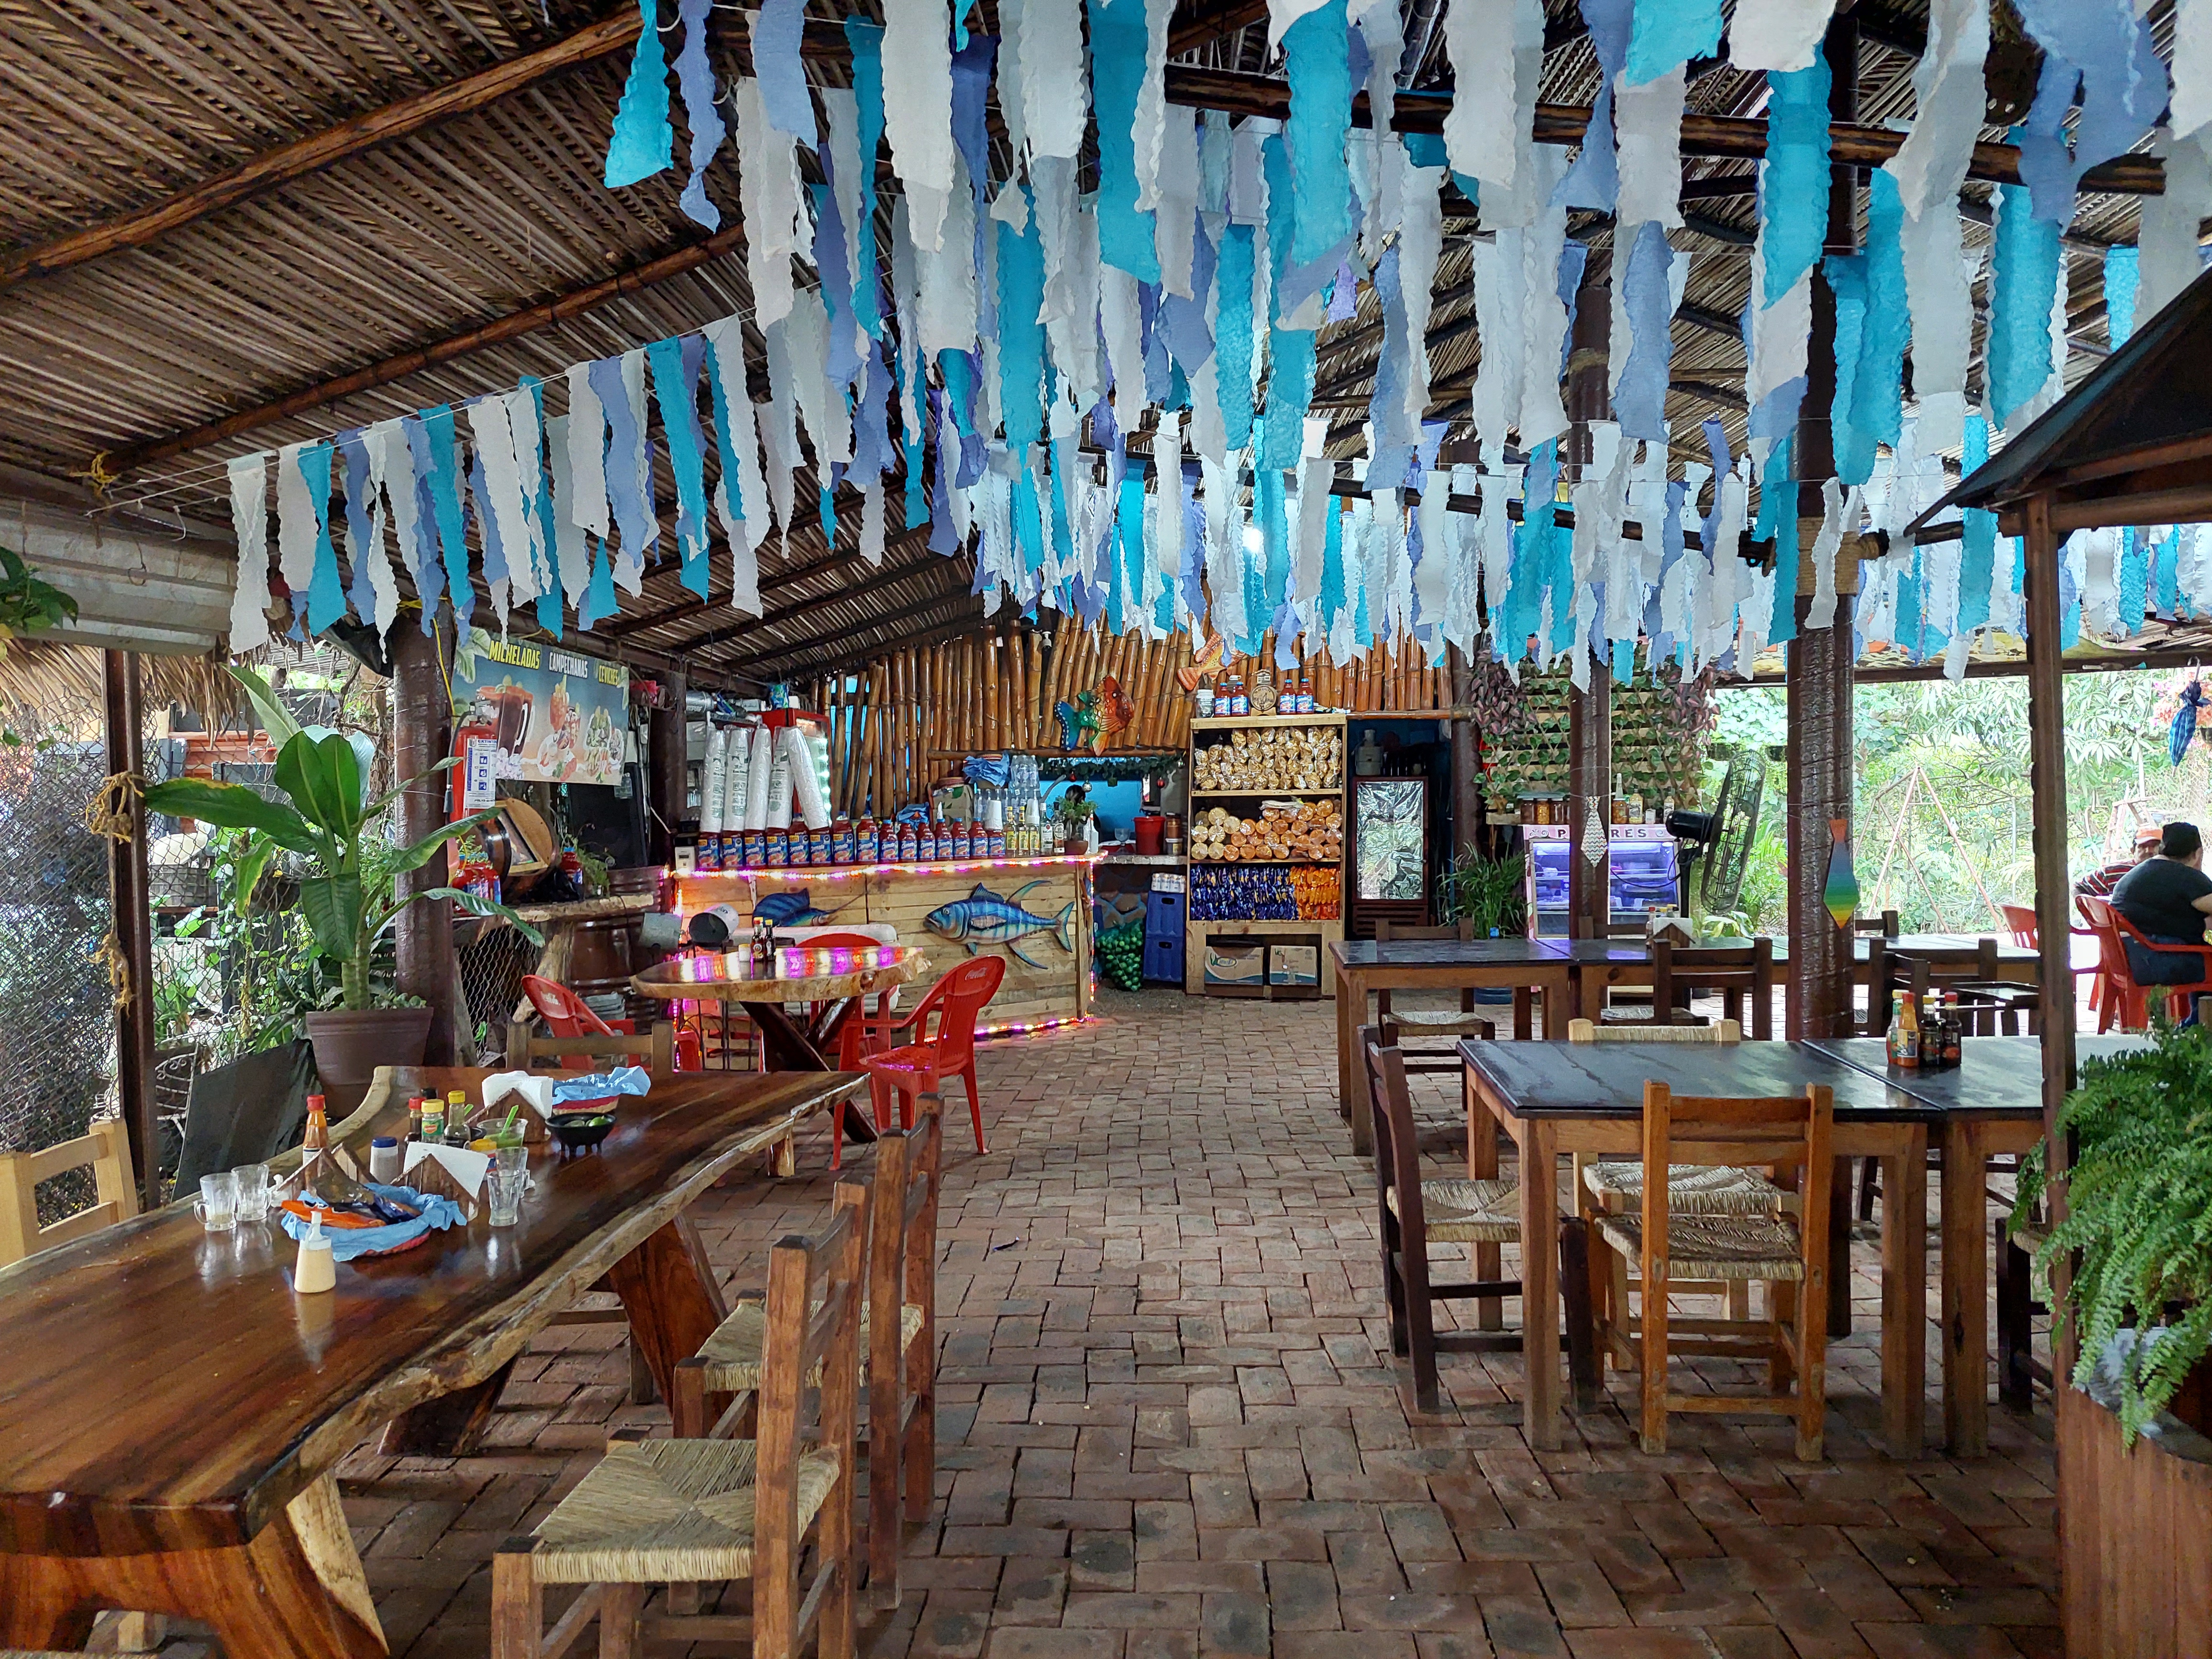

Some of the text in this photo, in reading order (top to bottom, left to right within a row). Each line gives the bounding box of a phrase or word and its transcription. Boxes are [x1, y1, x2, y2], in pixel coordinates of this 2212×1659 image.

[488, 640, 618, 686] MICHELADAS CAMPECHANAS CEVICHES
[1557, 828, 1647, 839] PRES
